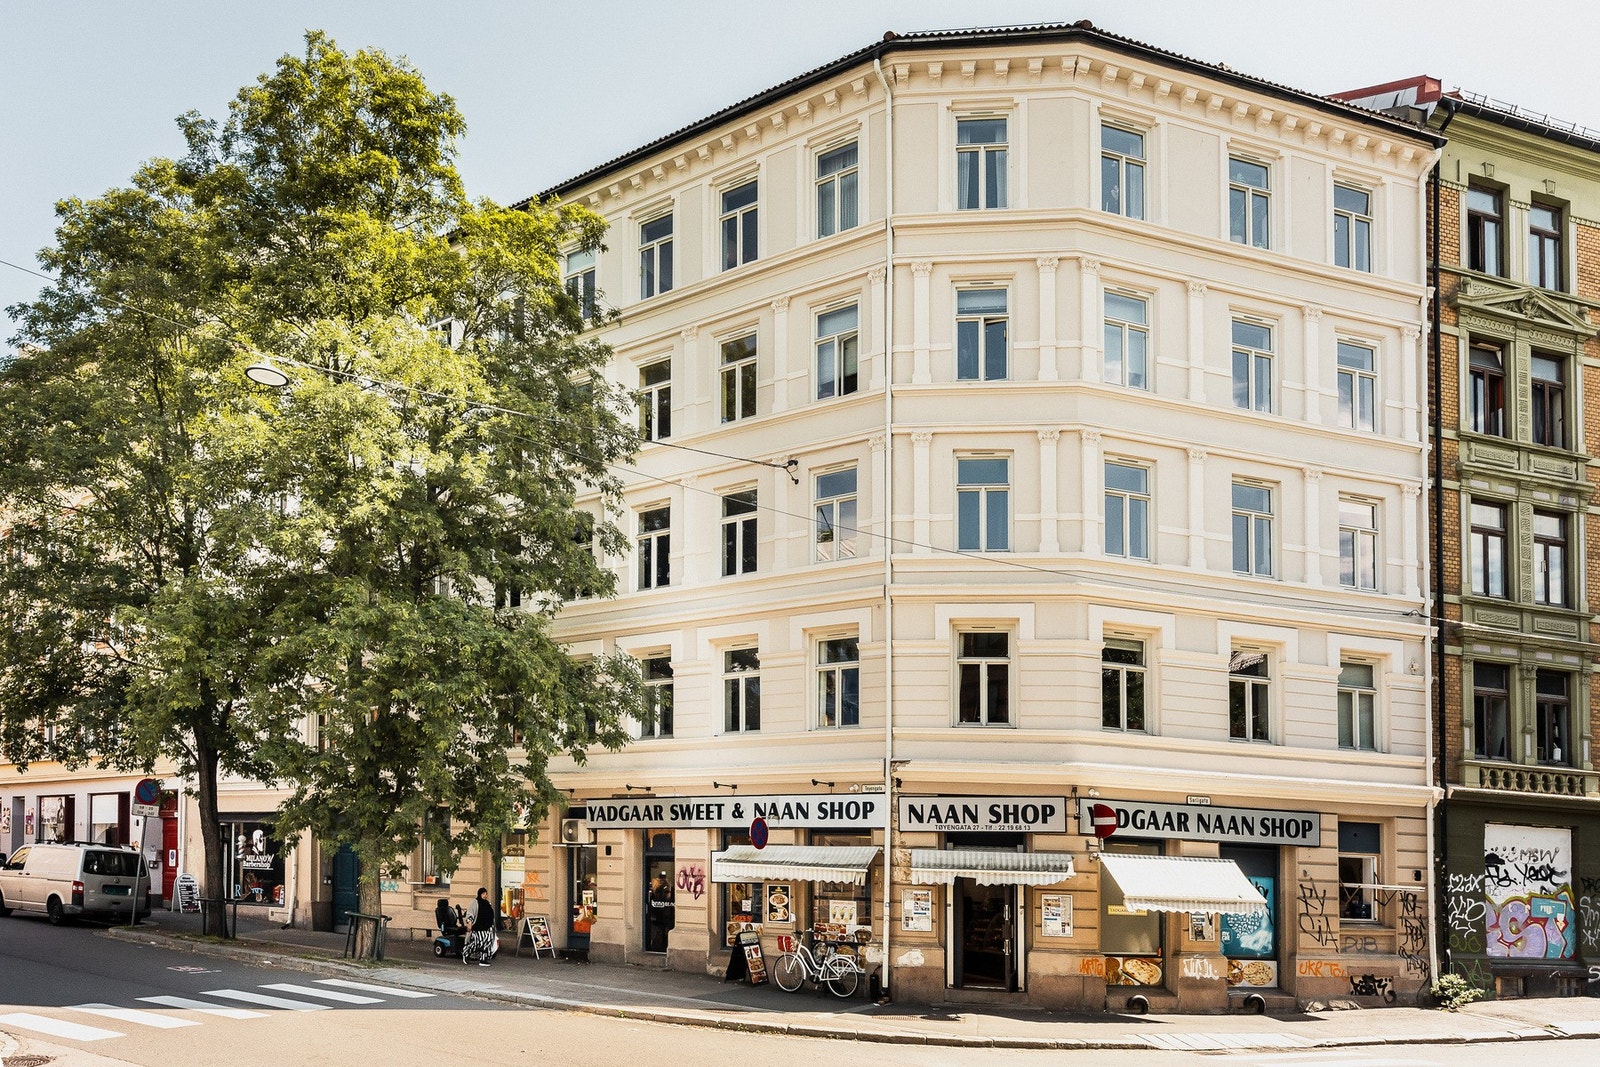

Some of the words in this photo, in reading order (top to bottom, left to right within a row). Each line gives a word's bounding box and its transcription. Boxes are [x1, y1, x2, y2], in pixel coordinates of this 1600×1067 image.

[588, 805, 664, 822] YADGAAR
[670, 803, 725, 821] SWEET
[731, 802, 744, 819] &
[753, 802, 809, 820] NAAN
[817, 801, 875, 820] SHOP
[908, 804, 979, 824] NAAN
[988, 804, 1056, 824] SHOP
[1196, 813, 1255, 836] NAAN
[1259, 817, 1314, 839] SHOP
